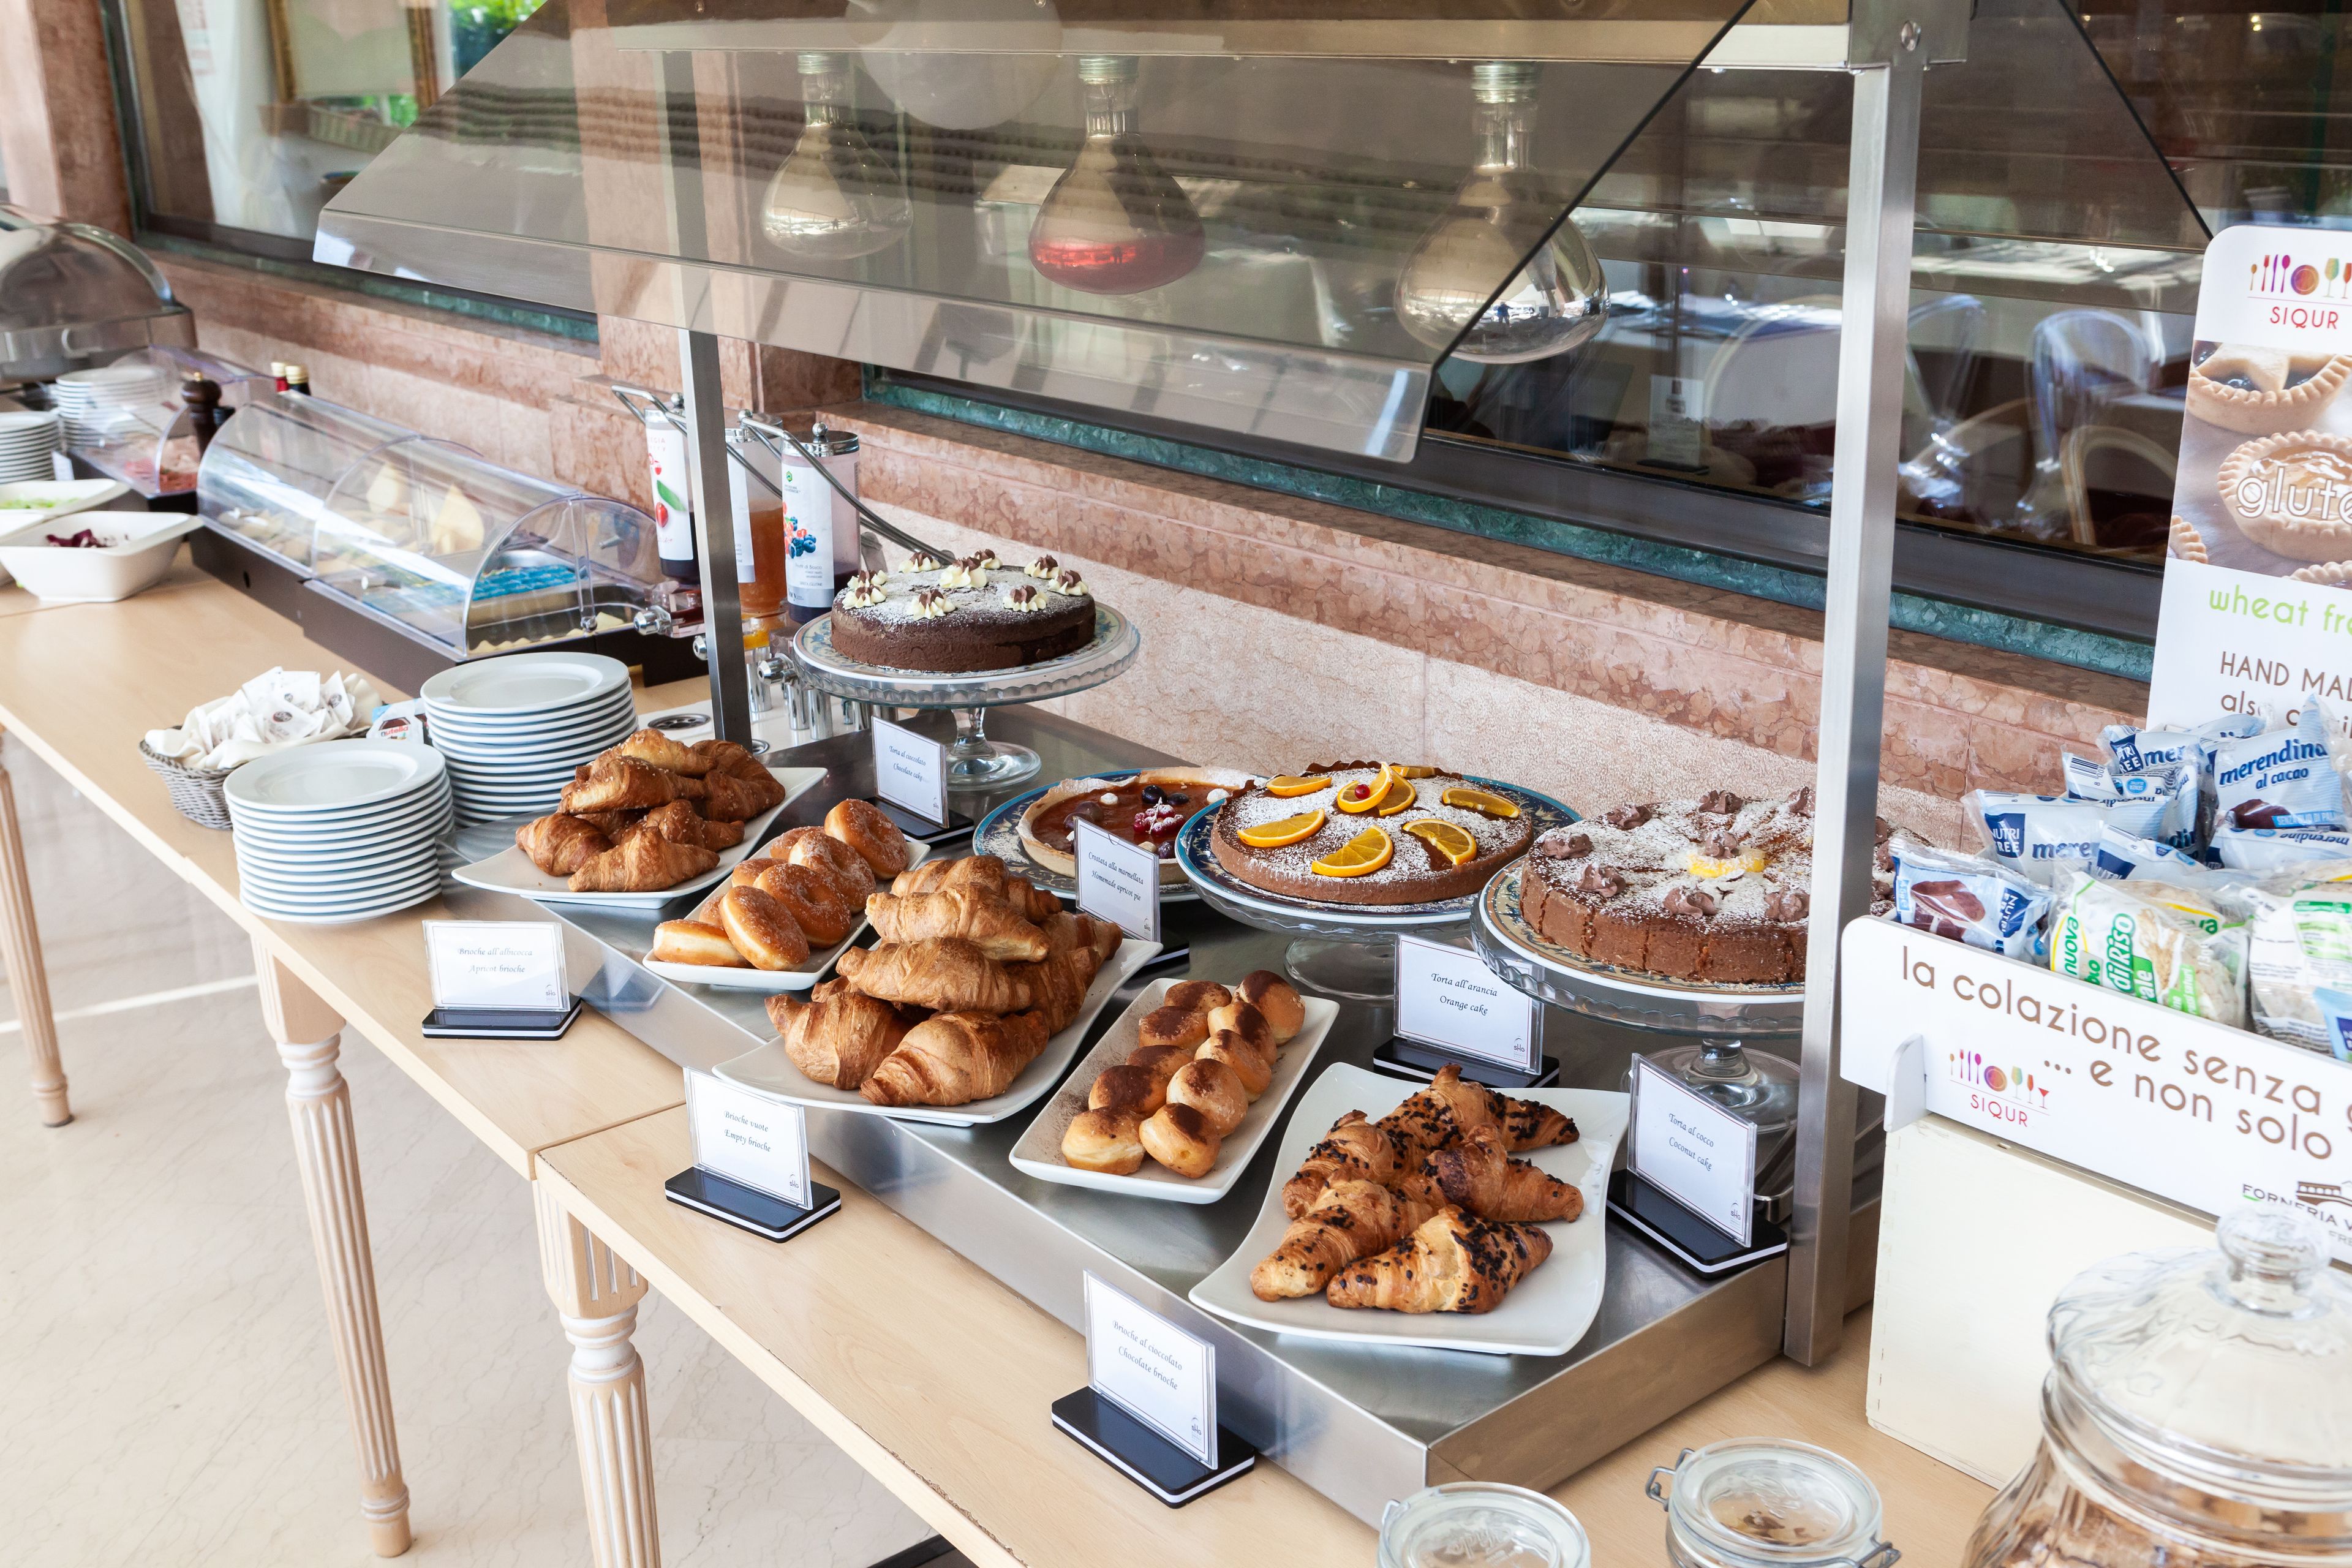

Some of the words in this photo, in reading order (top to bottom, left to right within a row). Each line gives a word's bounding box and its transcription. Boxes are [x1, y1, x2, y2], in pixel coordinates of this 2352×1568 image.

[2270, 306, 2339, 330] SIQUR
[2209, 584, 2309, 627] wheat
[2220, 651, 2290, 687] HAND
[2221, 691, 2261, 716] als
[381, 725, 409, 737] nutella
[893, 763, 913, 776] Chocolate
[2219, 739, 2329, 785] merendina
[2255, 773, 2267, 790] al
[2271, 767, 2309, 785] cacao
[1088, 851, 1107, 866] Crostata
[1108, 861, 1117, 871] alla
[1118, 867, 1144, 885] marmellata
[1091, 870, 1116, 889] Homemade
[1117, 884, 1133, 897] apricot
[469, 965, 497, 974] Apricot
[1431, 973, 1452, 986] Torta
[1439, 995, 1468, 1011] Orange
[1470, 1005, 1488, 1016] cake
[1903, 945, 1935, 989] la
[1953, 974, 2161, 1062] colazione
[2184, 1050, 2321, 1116] senza
[724, 1110, 748, 1125] Brioche
[750, 1121, 769, 1133] vuote
[1970, 1094, 2028, 1128] SIQUR
[2090, 1060, 2114, 1087] e
[2135, 1073, 2213, 1122] non
[2236, 1109, 2332, 1159] solo
[724, 1129, 747, 1145] Empty
[748, 1136, 771, 1152] brioche
[1668, 1113, 1687, 1131] Torta
[1688, 1126, 1695, 1136] al
[1697, 1132, 1714, 1148] cocco
[1669, 1137, 1696, 1159] Coconut
[1697, 1156, 1713, 1172] cake
[1112, 1320, 1138, 1342] Brioche
[1140, 1338, 1147, 1349] al
[1148, 1344, 1183, 1371] cioccolato
[1118, 1346, 1152, 1373] Chocolate
[1153, 1366, 1178, 1390] brioche
